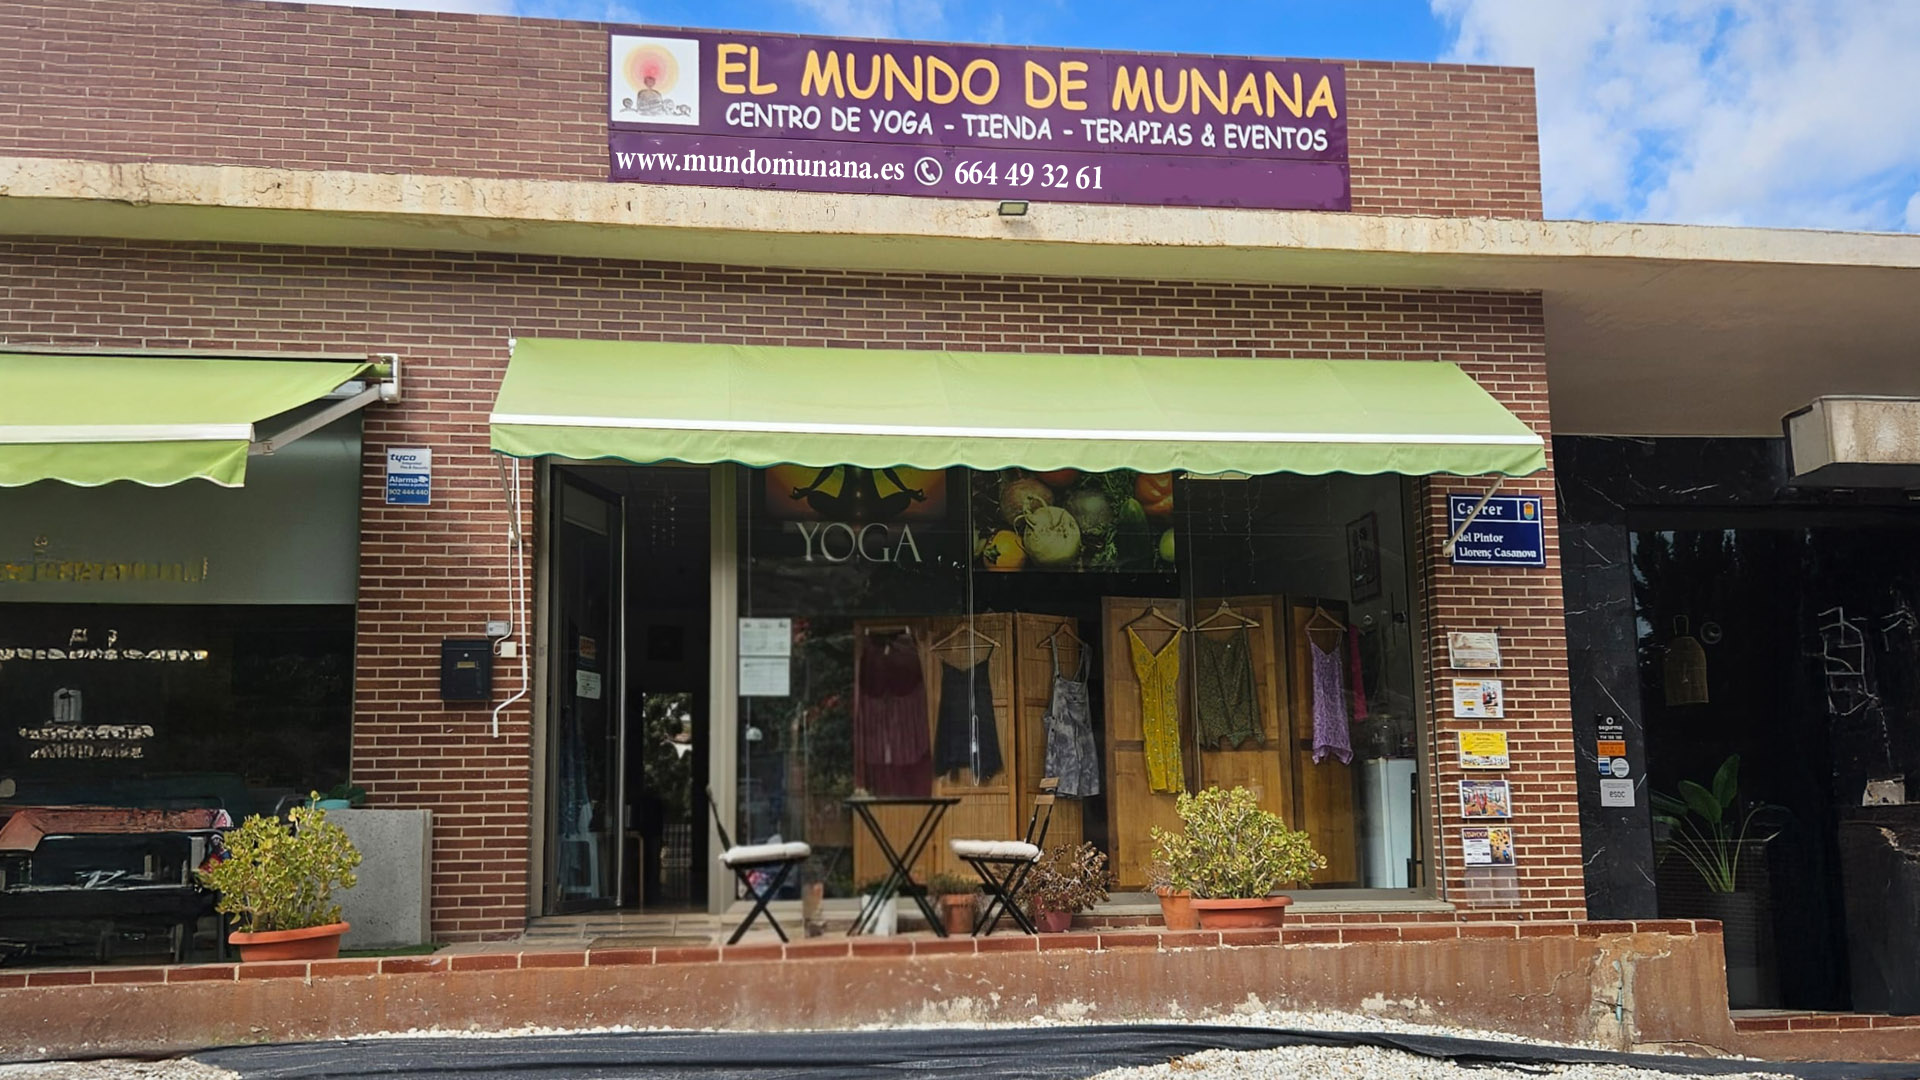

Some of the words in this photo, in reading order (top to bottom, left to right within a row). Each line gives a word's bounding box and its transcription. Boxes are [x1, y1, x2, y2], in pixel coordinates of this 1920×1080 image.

[717, 43, 778, 95] EL
[801, 50, 1000, 105] MUNDO
[1025, 60, 1089, 111] DE
[1112, 66, 1338, 119] MUNANA
[725, 102, 821, 130] CENTRO
[831, 107, 861, 132] DE
[869, 109, 933, 135] YOGA
[962, 113, 1052, 141] TIENDA
[1080, 118, 1193, 147] TERAPIAS
[1201, 124, 1216, 147] &
[1224, 124, 1328, 151] EVENTOS
[616, 149, 905, 181] www.mundomunana.es
[954, 160, 998, 186] 664
[1004, 162, 1035, 187] 49
[1041, 163, 1070, 189] 32
[1075, 165, 1103, 190] 61
[390, 453, 417, 462] tyco
[1457, 502, 1503, 515] Carer
[796, 522, 922, 563] YOGA
[1473, 533, 1504, 543] Pintor
[1459, 547, 1492, 559] Llorenç
[1494, 547, 1537, 558] Casanova
